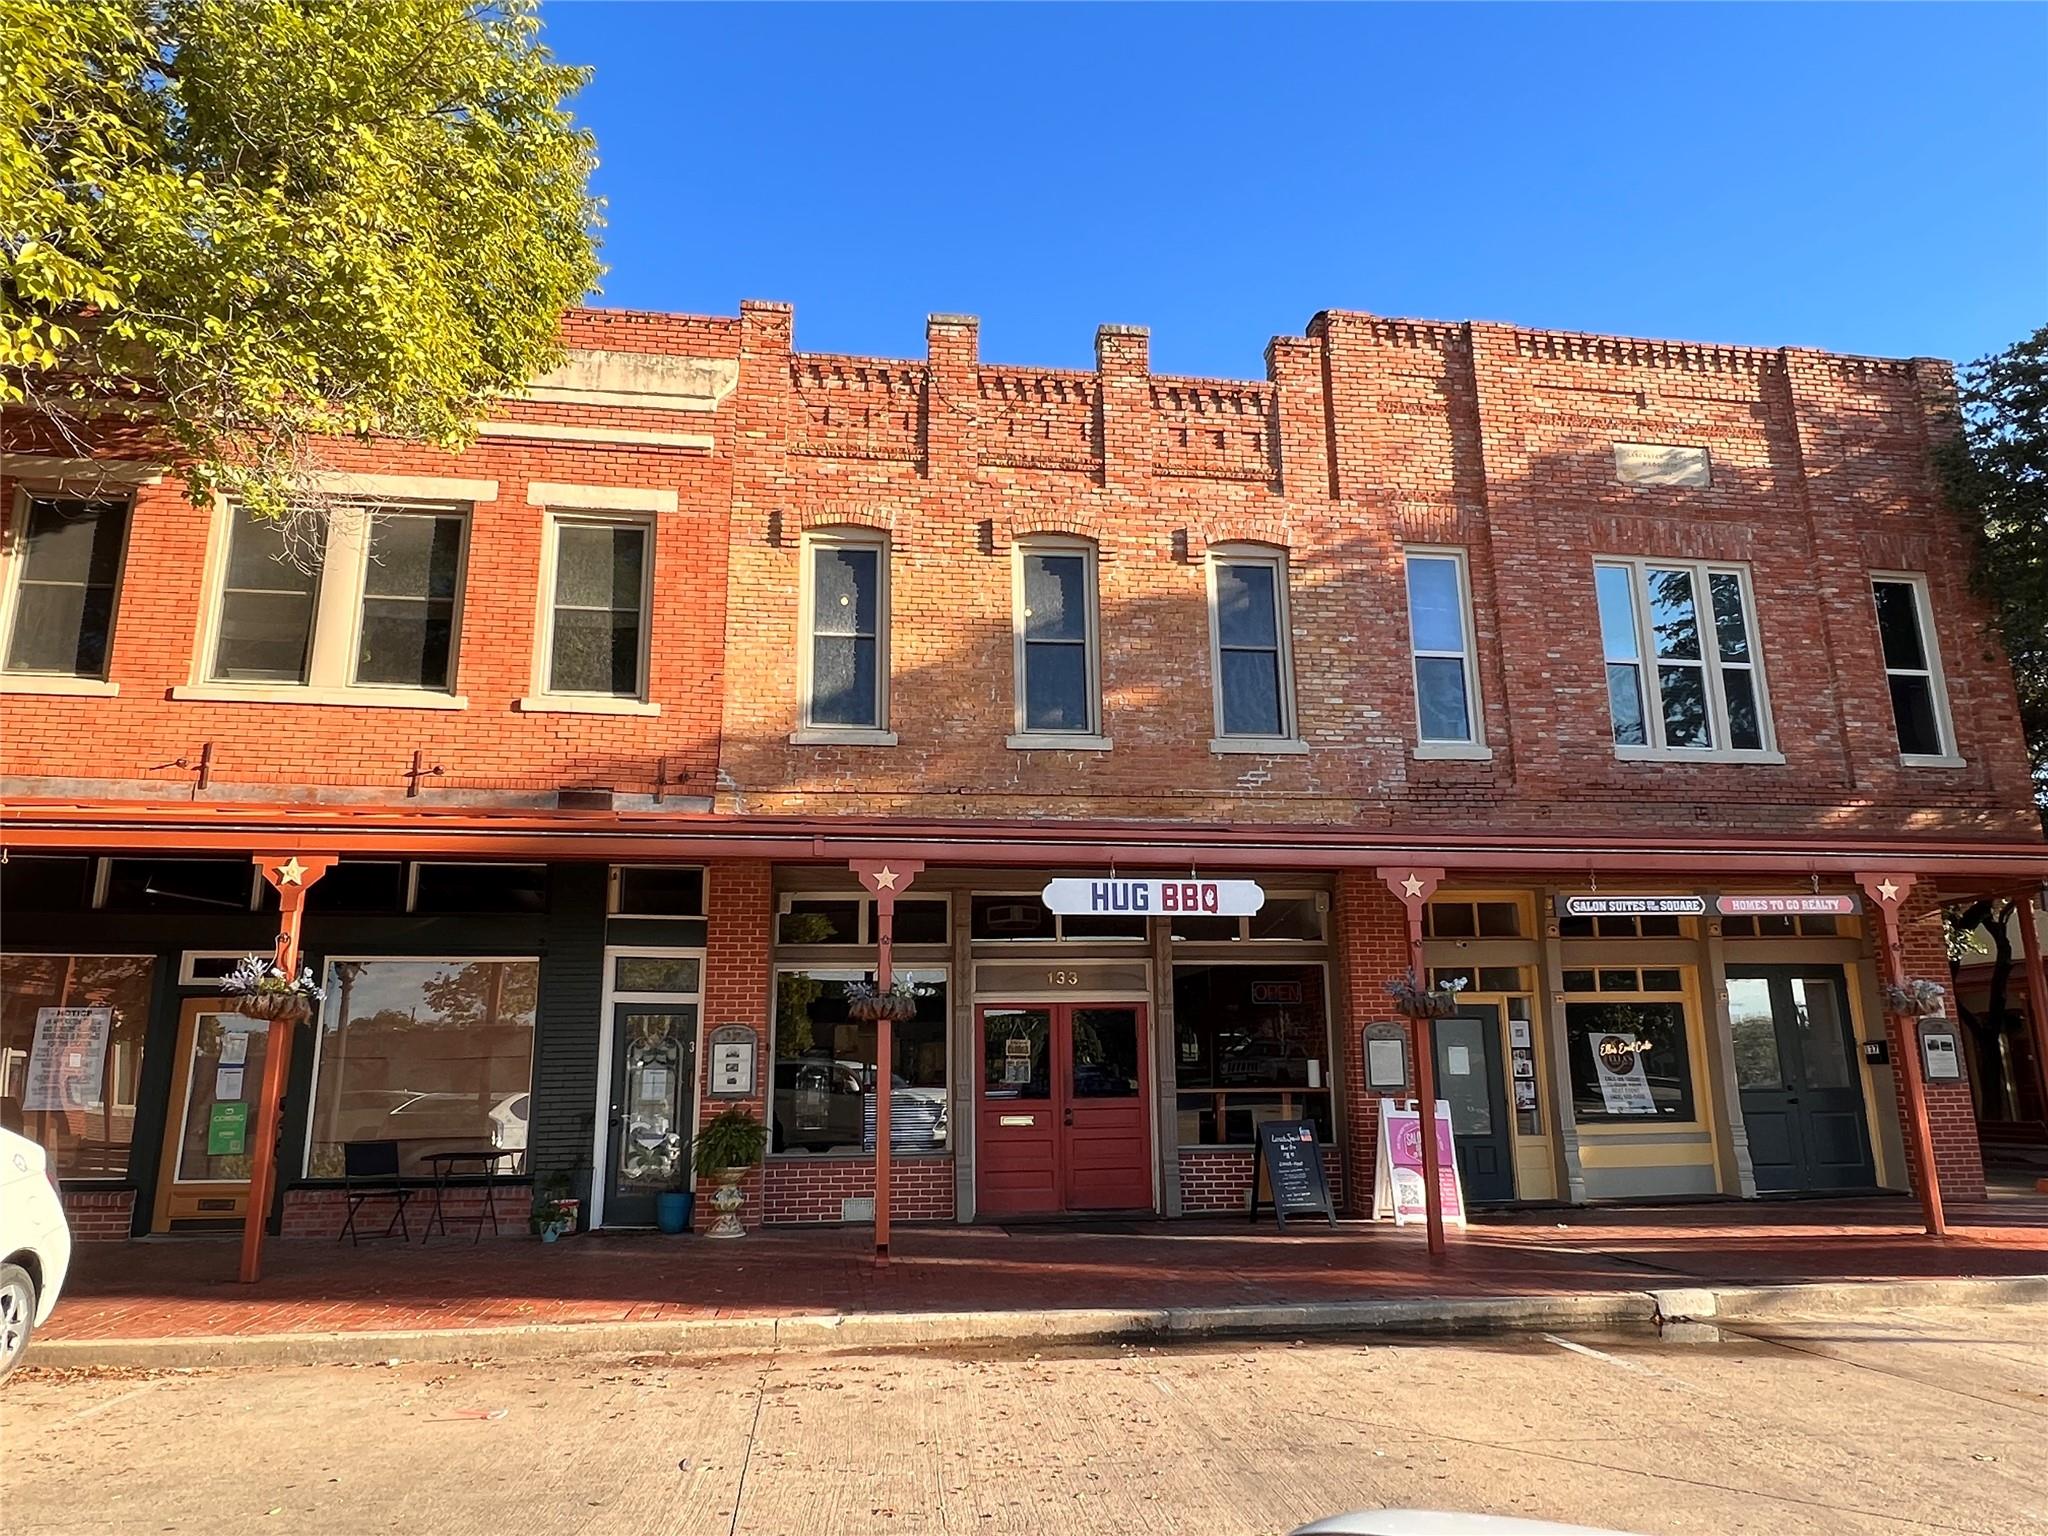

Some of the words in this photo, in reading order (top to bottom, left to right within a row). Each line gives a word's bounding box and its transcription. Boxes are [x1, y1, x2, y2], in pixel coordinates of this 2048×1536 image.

[1091, 882, 1149, 911] HUG
[1162, 883, 1218, 914] BBQ
[1732, 900, 1769, 911] HOMES
[1769, 900, 1784, 911] TO
[1786, 900, 1800, 911] GO
[1802, 899, 1840, 911] REALTY
[1573, 901, 1607, 912] SALON
[1609, 901, 1646, 912] SUITES
[1660, 900, 1700, 912] SQUARE
[1048, 971, 1079, 985] 133
[1255, 984, 1300, 1001] OPEN
